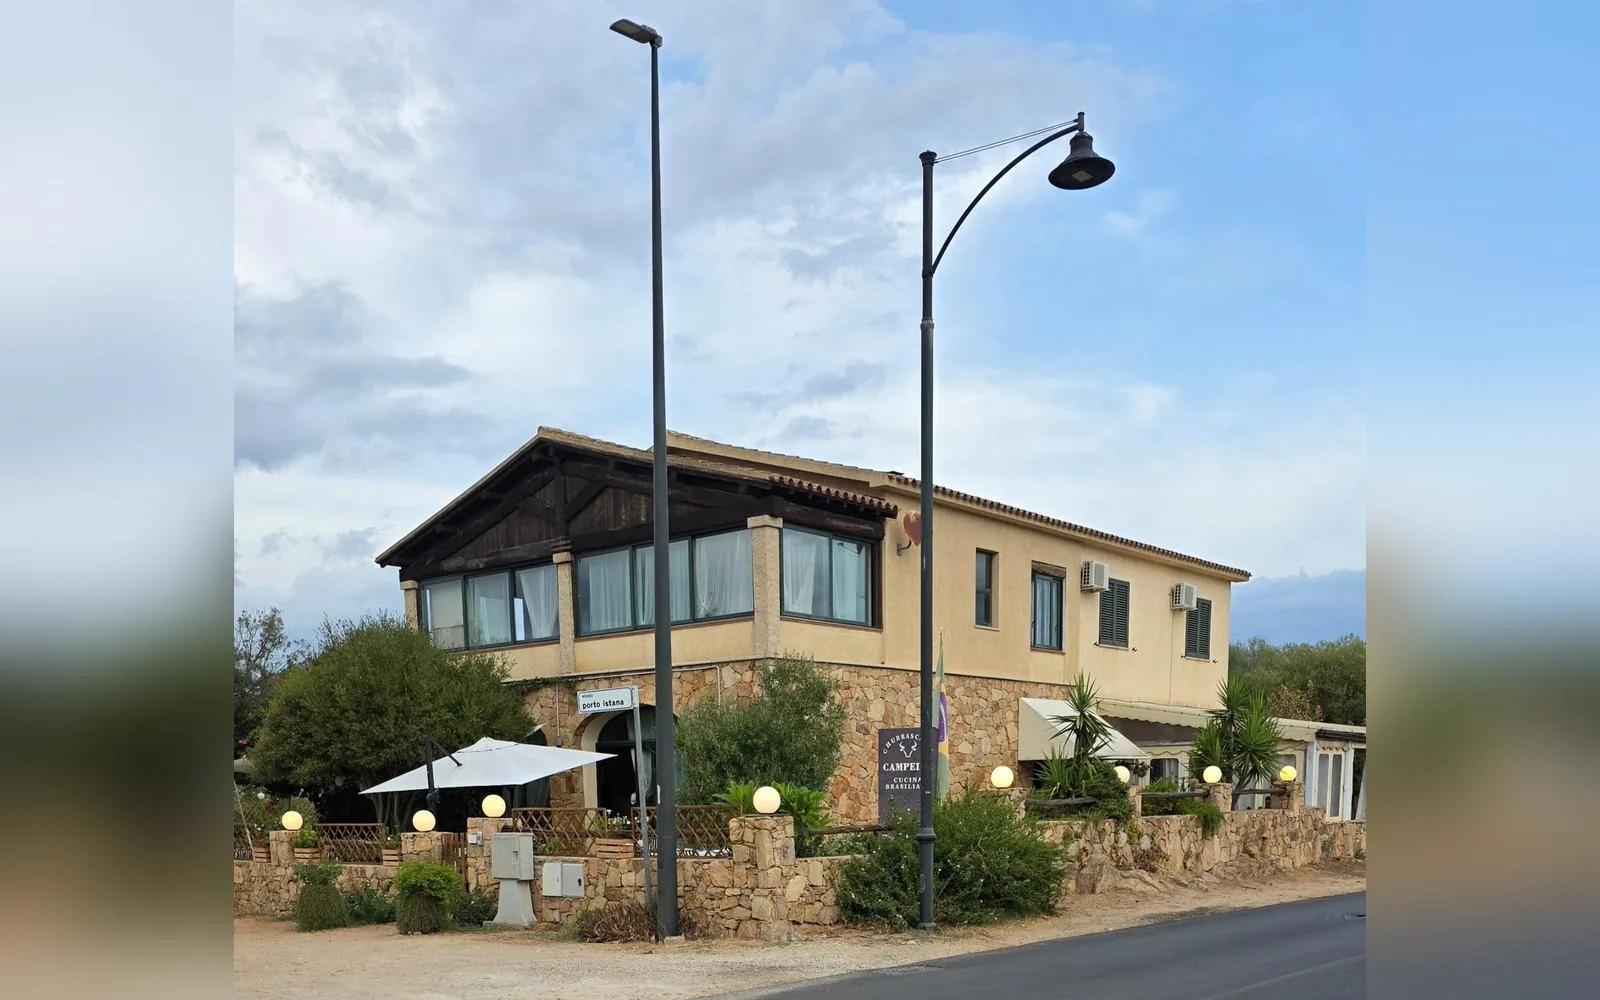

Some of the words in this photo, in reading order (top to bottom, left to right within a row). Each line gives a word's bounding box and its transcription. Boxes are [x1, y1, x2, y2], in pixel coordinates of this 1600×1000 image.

[582, 701, 600, 710] porto
[882, 733, 921, 754] CHURRASC
[882, 762, 921, 771] CAMPEI
